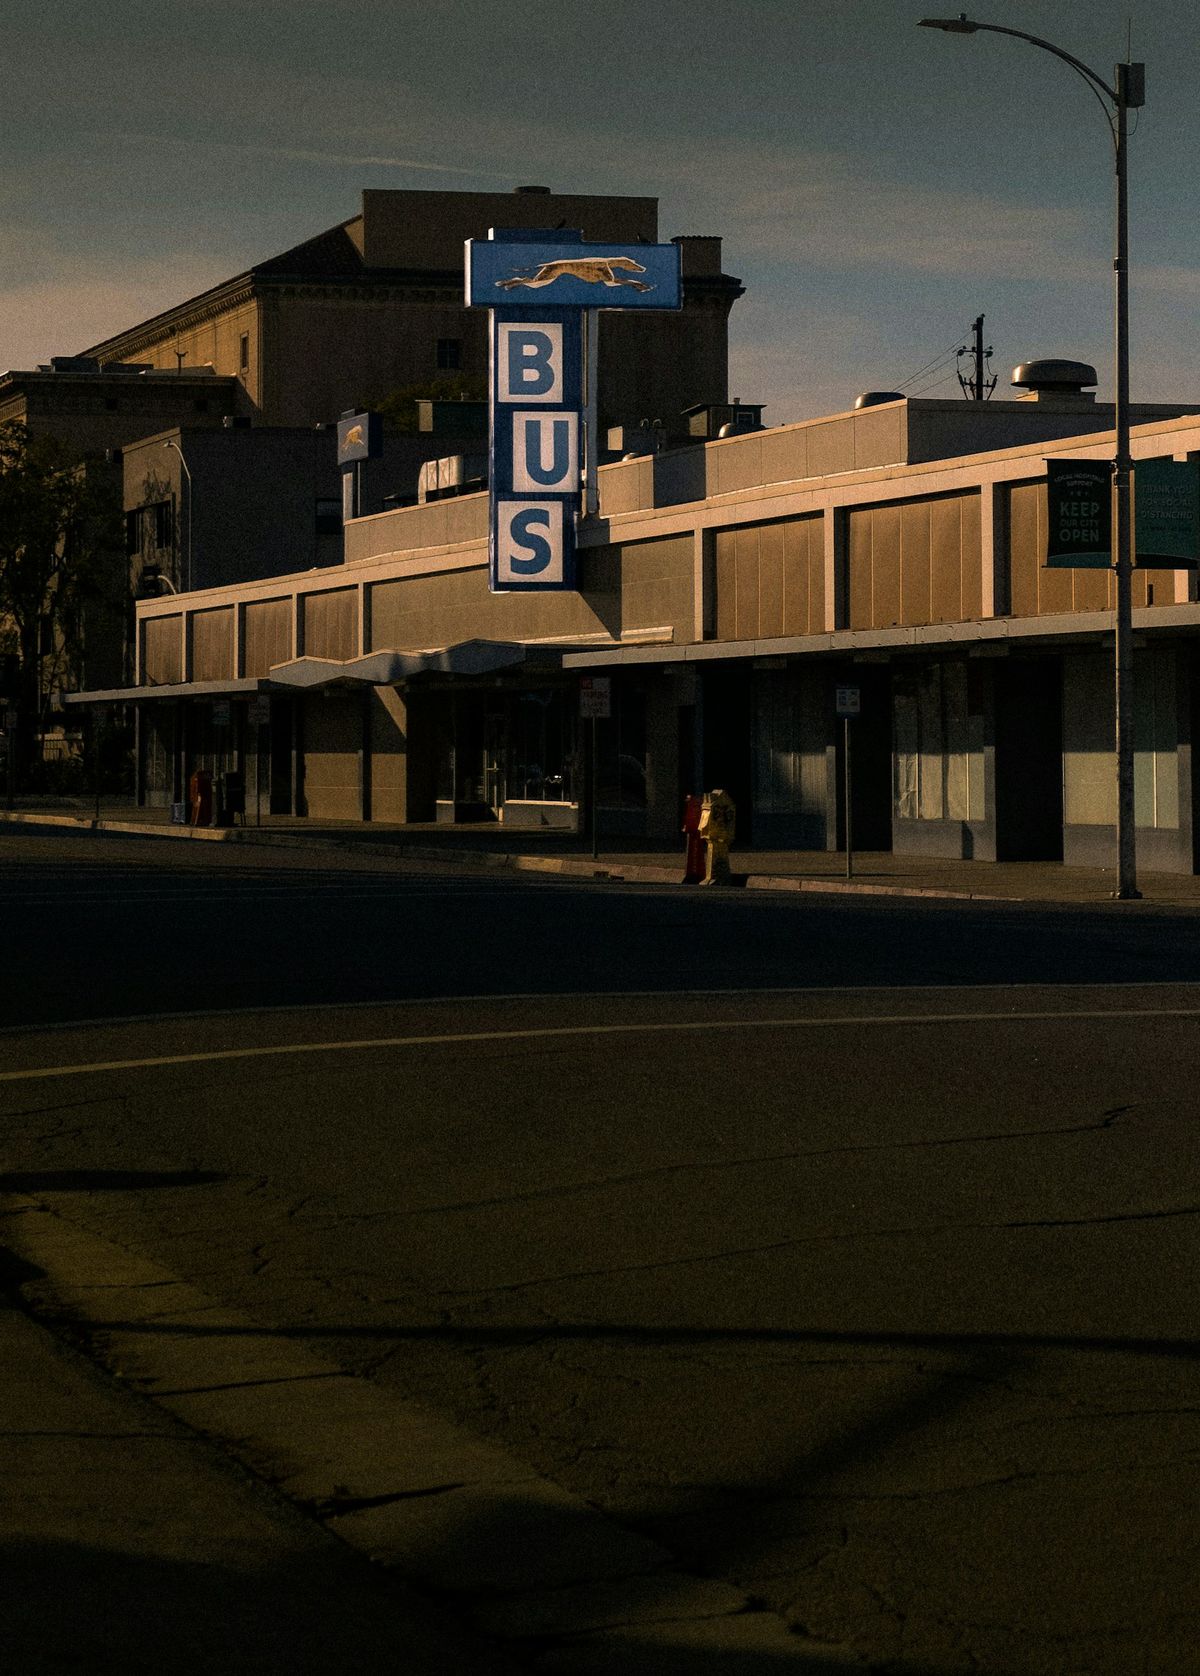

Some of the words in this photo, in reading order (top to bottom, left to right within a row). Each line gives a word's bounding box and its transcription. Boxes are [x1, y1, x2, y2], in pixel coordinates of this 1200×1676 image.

[508, 331, 569, 575] BUS
[1059, 501, 1100, 517] KEEP
[1059, 519, 1078, 527] OUR
[1079, 519, 1099, 527] CITY
[1059, 528, 1100, 542] OPEN
